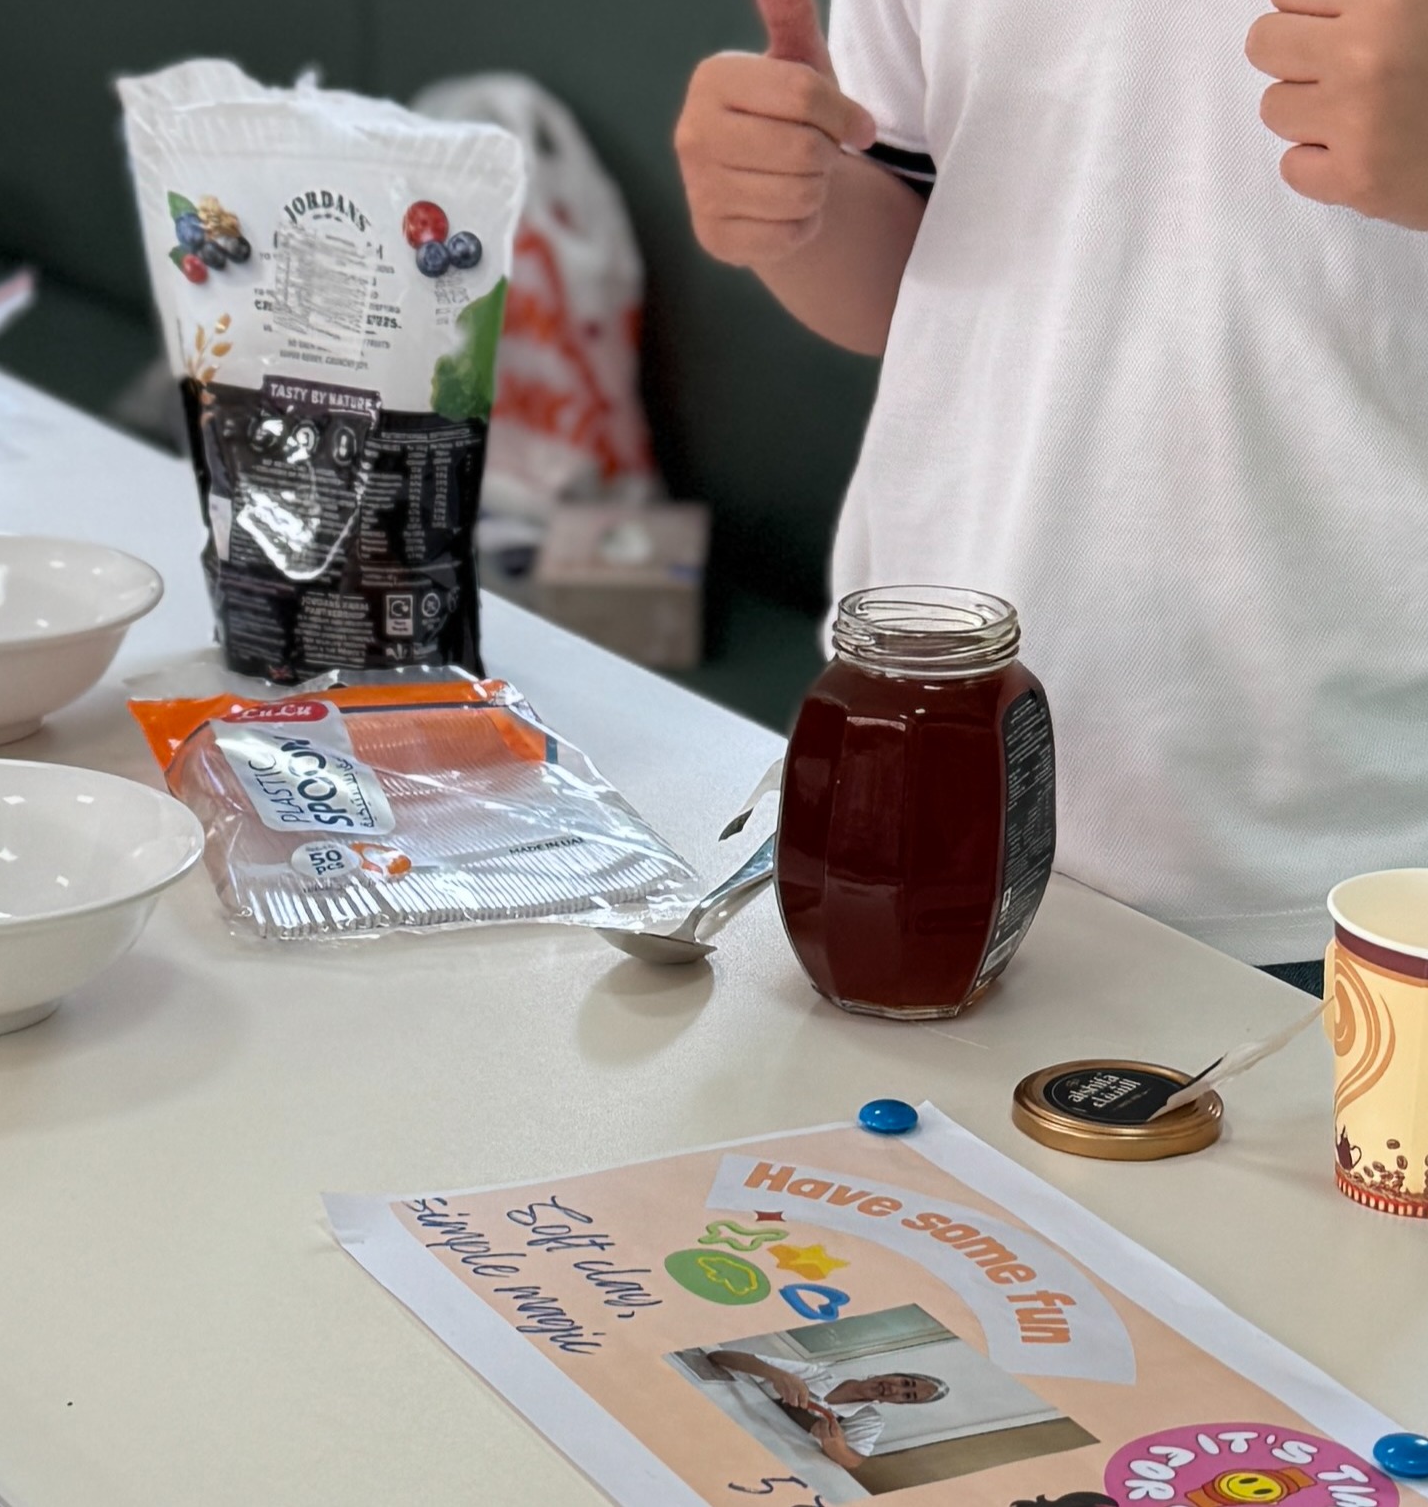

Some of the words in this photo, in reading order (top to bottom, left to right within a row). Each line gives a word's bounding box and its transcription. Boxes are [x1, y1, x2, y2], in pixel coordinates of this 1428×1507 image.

[270, 383, 309, 401] TASTY
[311, 390, 328, 405] BY
[248, 755, 312, 824] PLASTIC
[309, 849, 343, 867] 50
[315, 862, 345, 876] pcs
[509, 844, 545, 855] MADE
[544, 841, 560, 849] IN
[506, 1195, 616, 1252] Soft
[573, 1260, 664, 1319] clay,
[743, 1161, 904, 1218] Have
[900, 1211, 1038, 1286] some
[1006, 1289, 1077, 1345] fun
[493, 1286, 607, 1355] magic
[1195, 1431, 1319, 1465] IT'S
[1122, 1445, 1196, 1501] FOR
